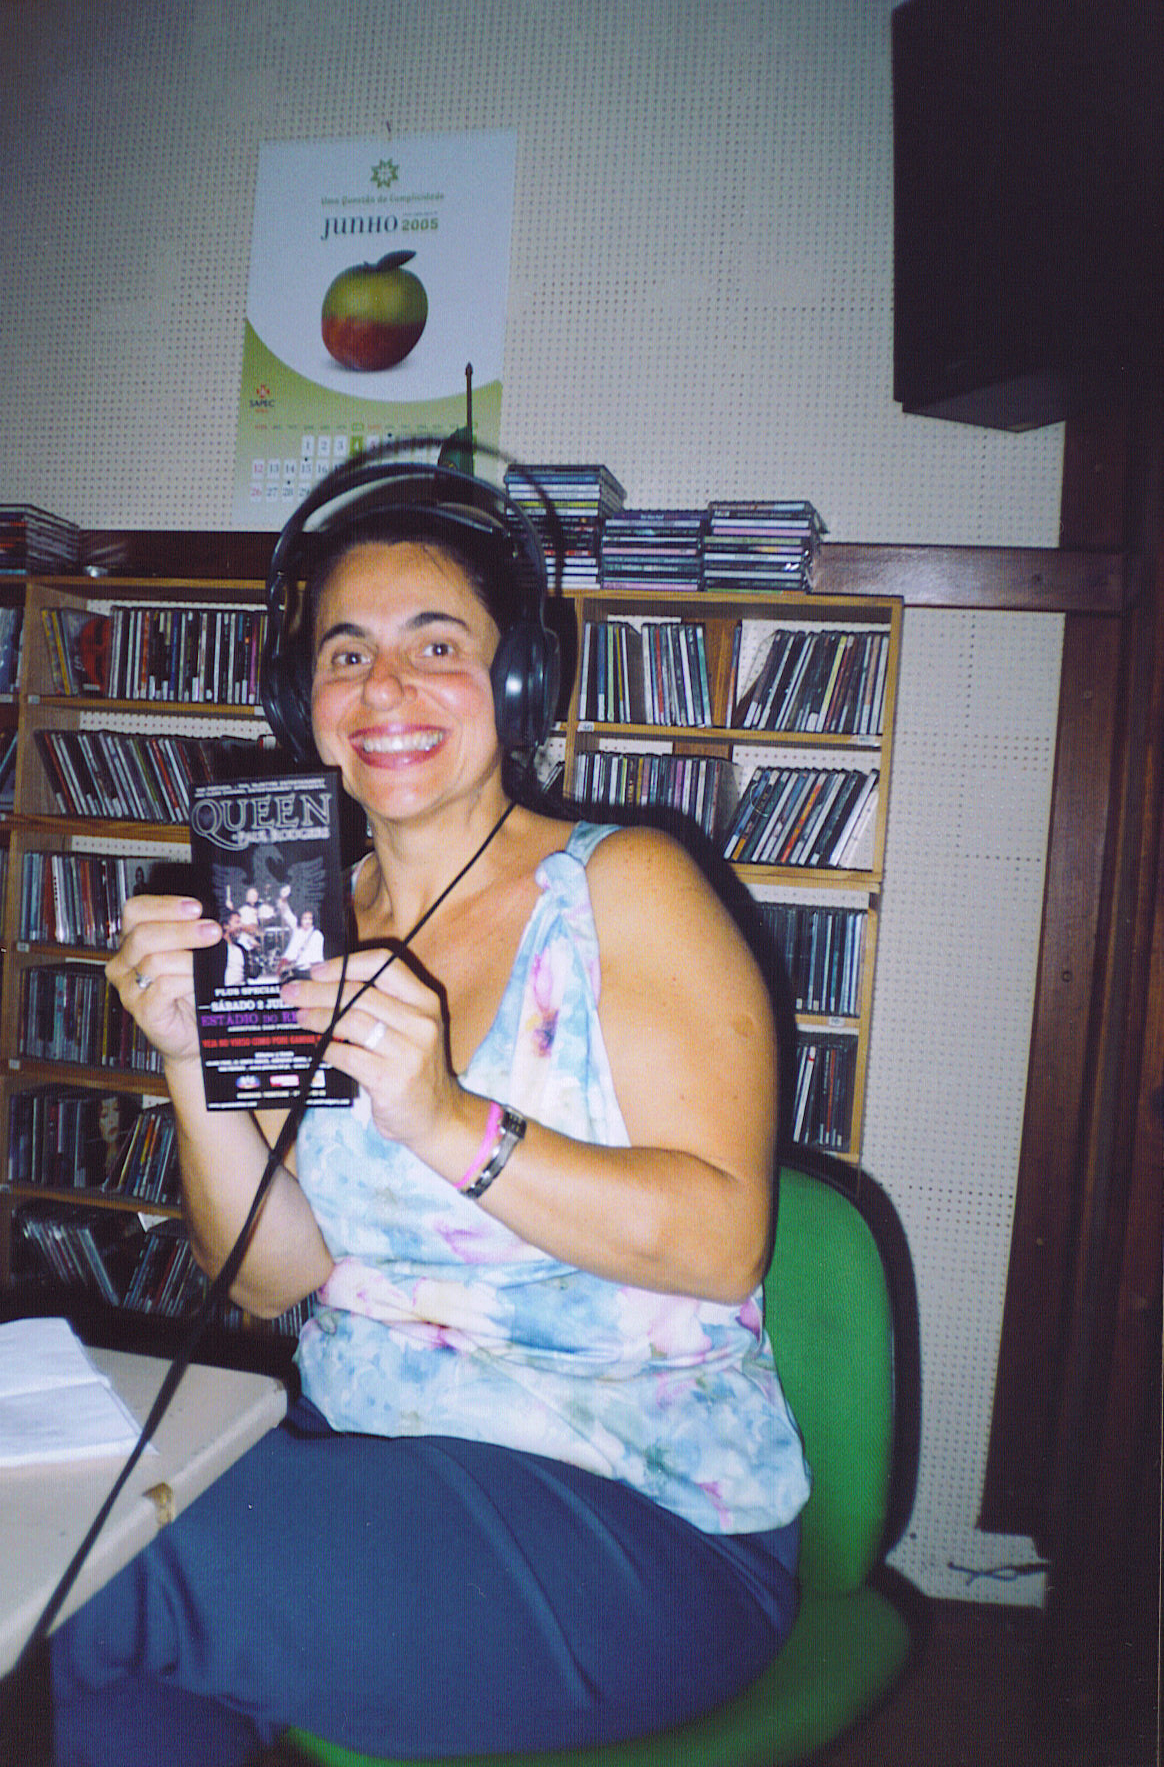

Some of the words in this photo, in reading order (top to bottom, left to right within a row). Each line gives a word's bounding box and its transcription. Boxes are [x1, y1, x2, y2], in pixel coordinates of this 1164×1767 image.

[401, 217, 439, 232] 2005
[320, 440, 328, 451] 2
[253, 463, 264, 473] 12
[285, 464, 295, 474] 14
[301, 464, 312, 474] 15
[191, 793, 332, 852] QUEEN
[214, 987, 240, 998] PLUS
[210, 998, 256, 1013] SÁBADO
[201, 1011, 259, 1027] ESTÁDIO
